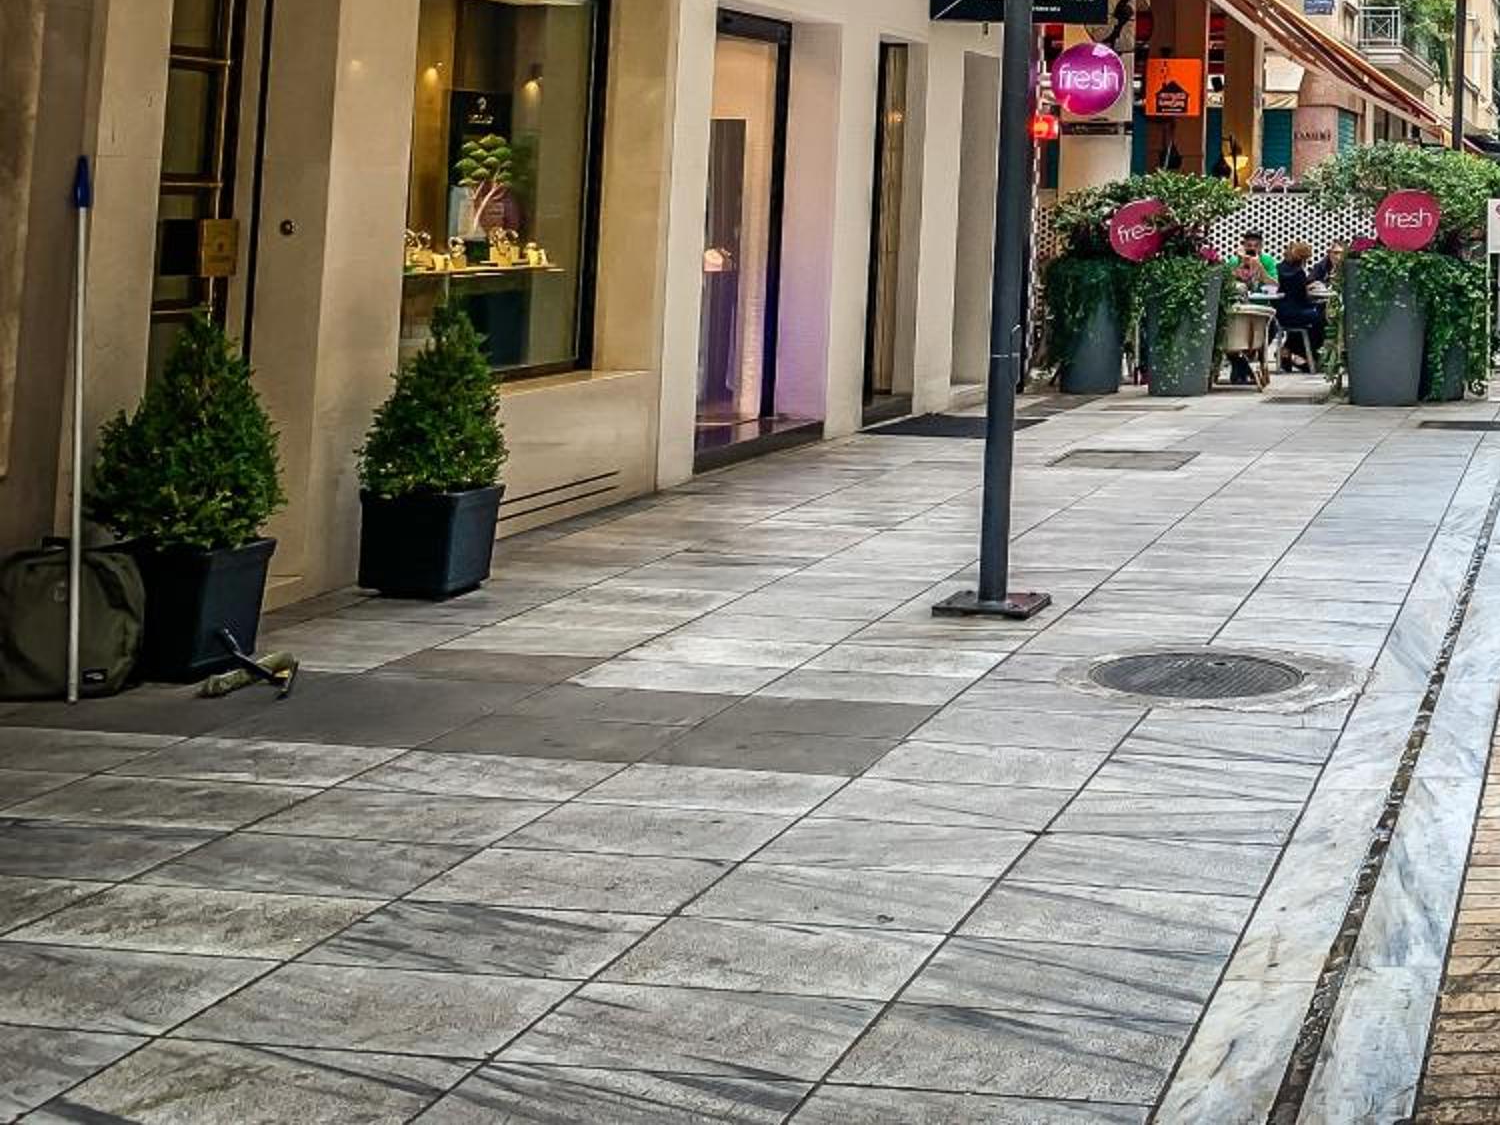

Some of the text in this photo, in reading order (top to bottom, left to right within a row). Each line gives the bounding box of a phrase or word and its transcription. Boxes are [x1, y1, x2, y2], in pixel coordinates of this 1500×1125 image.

[1059, 62, 1120, 92] fresh
[1385, 208, 1433, 228] fresh
[1117, 224, 1157, 244] fres
